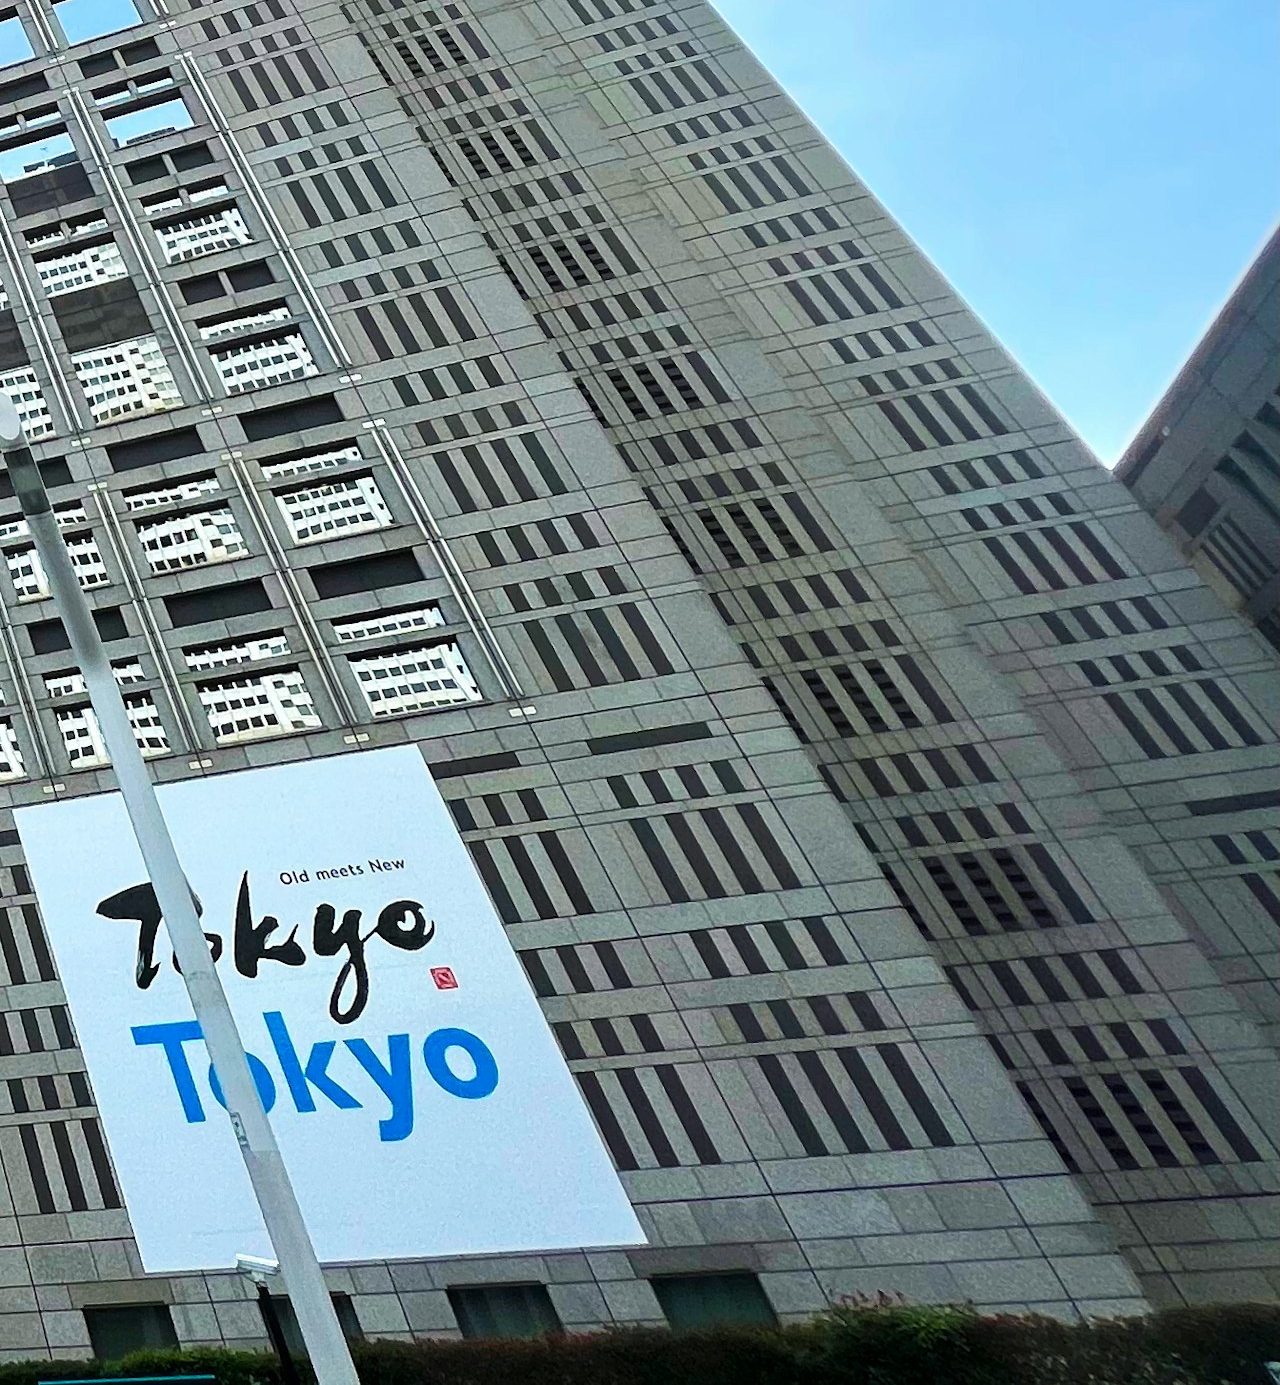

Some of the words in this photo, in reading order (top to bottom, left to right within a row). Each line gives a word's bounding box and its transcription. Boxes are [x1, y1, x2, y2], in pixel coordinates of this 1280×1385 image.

[279, 869, 310, 885] Old
[315, 864, 364, 881] meets
[367, 858, 405, 874] New
